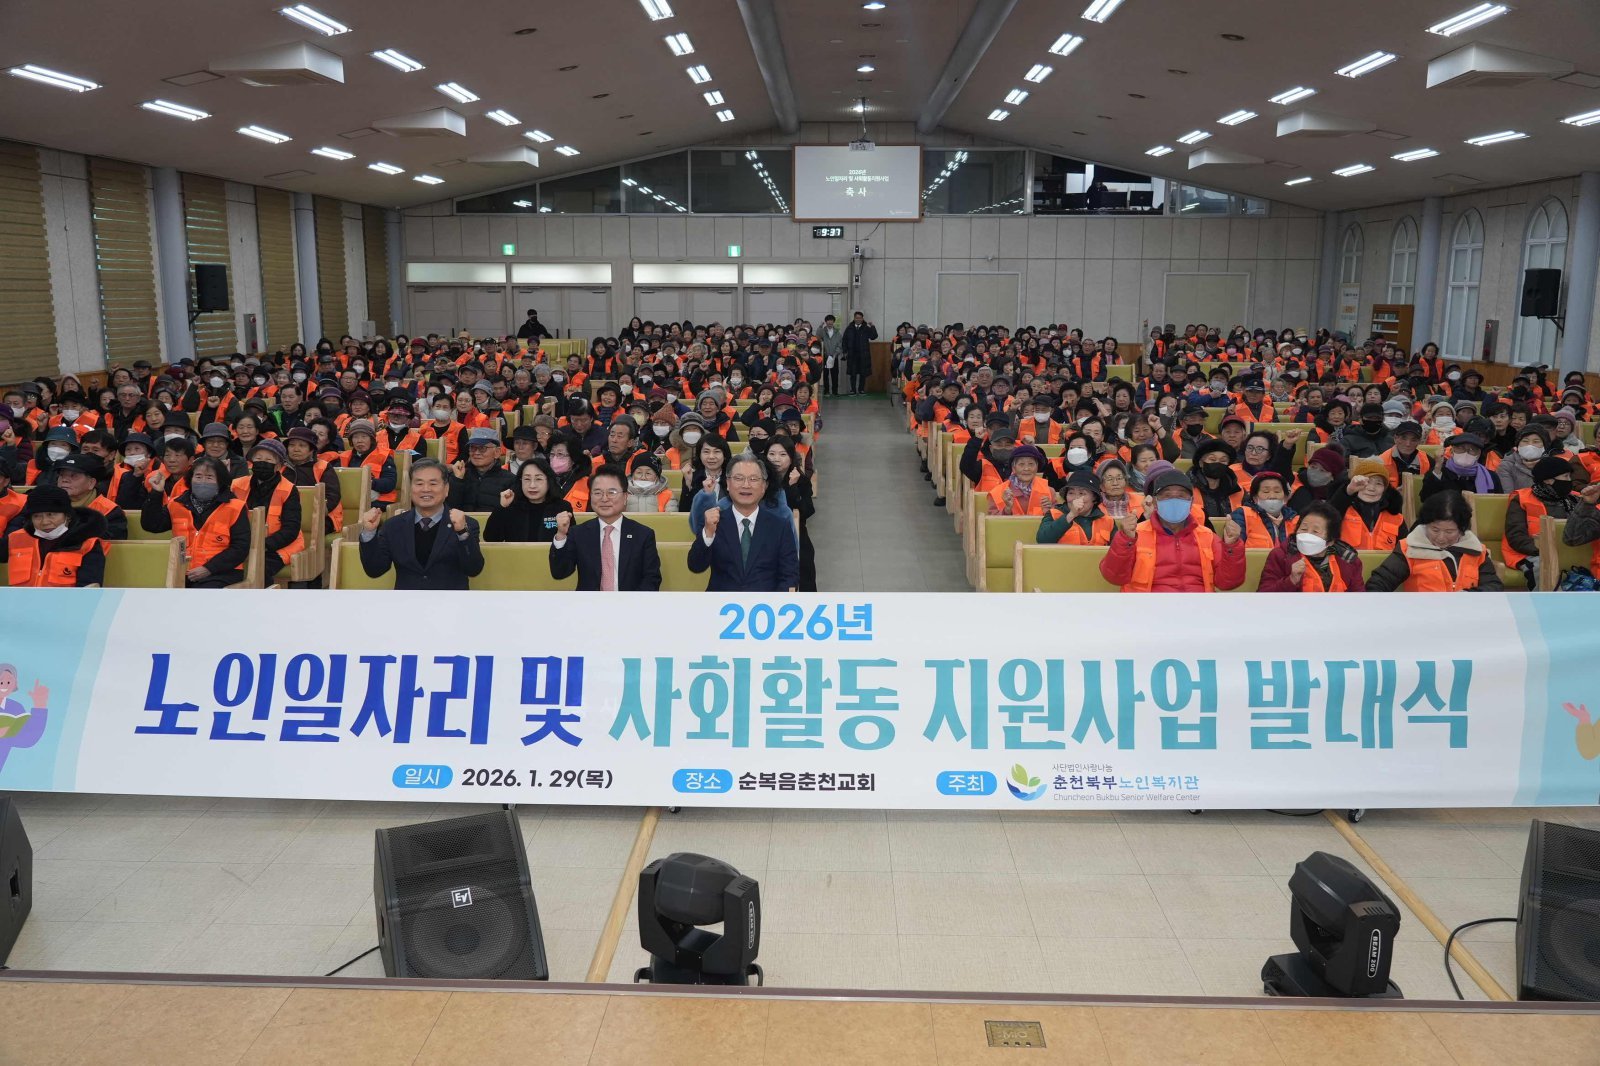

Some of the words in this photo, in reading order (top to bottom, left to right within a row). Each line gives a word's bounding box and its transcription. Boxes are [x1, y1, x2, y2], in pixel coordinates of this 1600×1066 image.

[821, 228, 841, 237] 9:37
[719, 602, 874, 642] 2026년
[134, 652, 495, 746] 노인일자리
[520, 655, 585, 748] 및
[608, 655, 900, 751] 사회활동
[922, 658, 1218, 752] 지원사업
[1245, 659, 1473, 752] 발대식
[404, 767, 441, 786] 일시
[461, 768, 522, 788] 2026.
[529, 769, 543, 787] 1.
[549, 769, 614, 789] 29(목)
[685, 772, 722, 791] 장소
[738, 771, 875, 792] 순복음춘천교회
[947, 774, 985, 793] 주최
[1052, 774, 1200, 791] 춘천북부노인복지관
[1053, 793, 1095, 801] Chuncheon
[1096, 793, 1120, 801] Bukbu
[1121, 793, 1145, 801] Senior
[1146, 793, 1175, 801] Welfare
[1175, 793, 1201, 801] Center
[1369, 959, 1377, 972] 200
